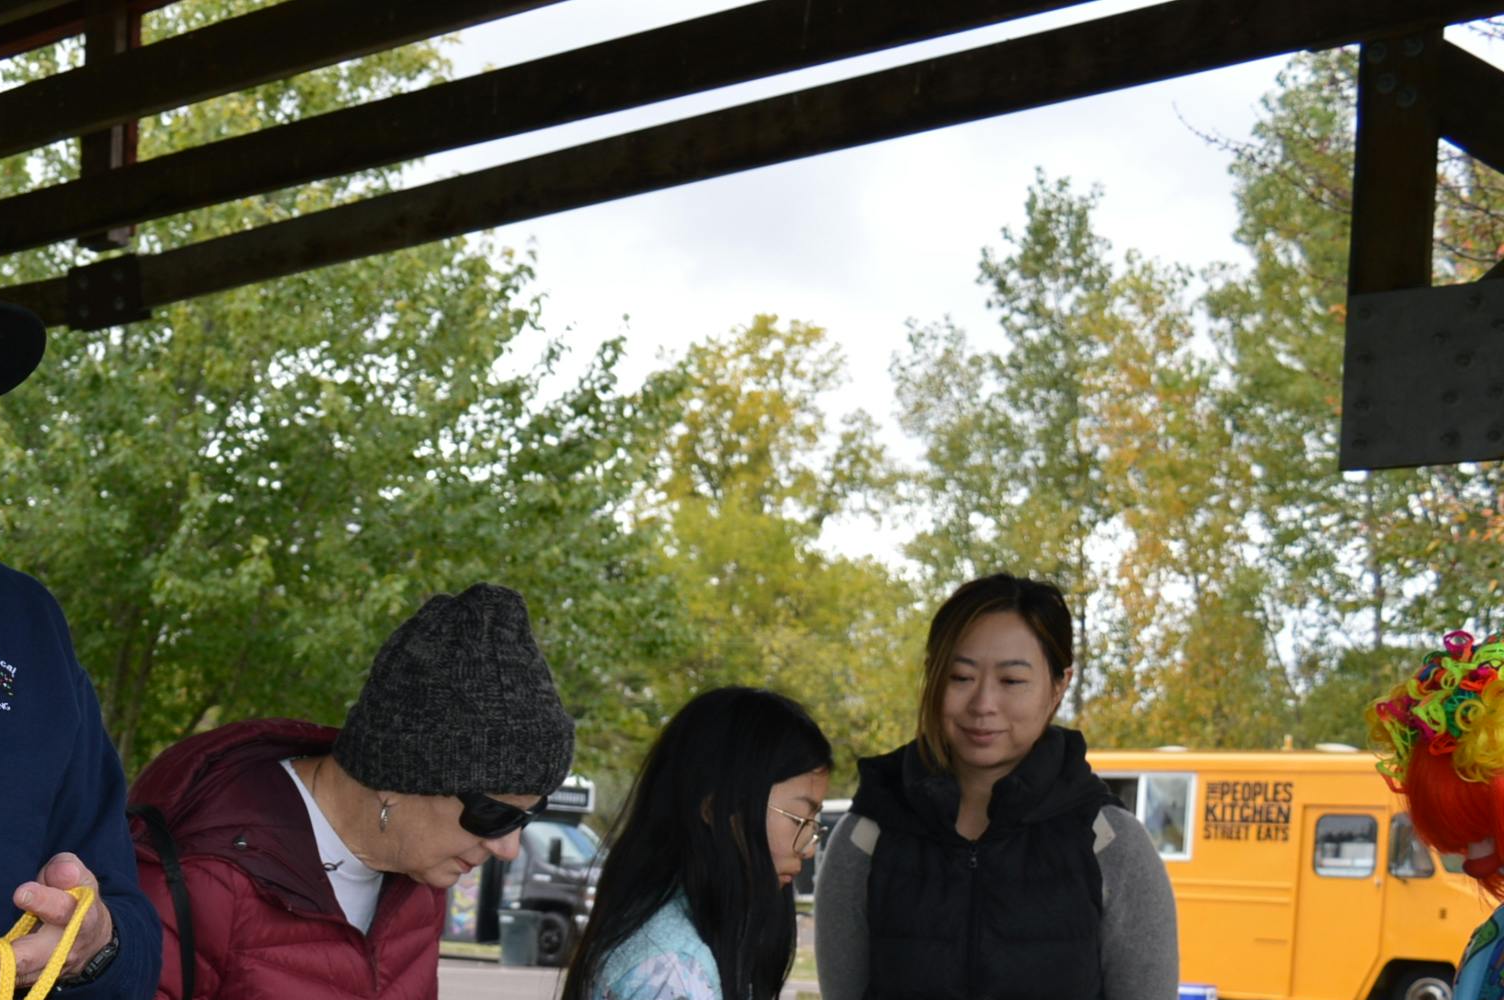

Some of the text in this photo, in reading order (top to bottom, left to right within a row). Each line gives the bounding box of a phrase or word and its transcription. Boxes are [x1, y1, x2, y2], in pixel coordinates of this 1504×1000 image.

[1221, 781, 1294, 802] PEOPLES
[1205, 802, 1291, 823] KITCHEN
[1203, 824, 1290, 842] STREET EATS
